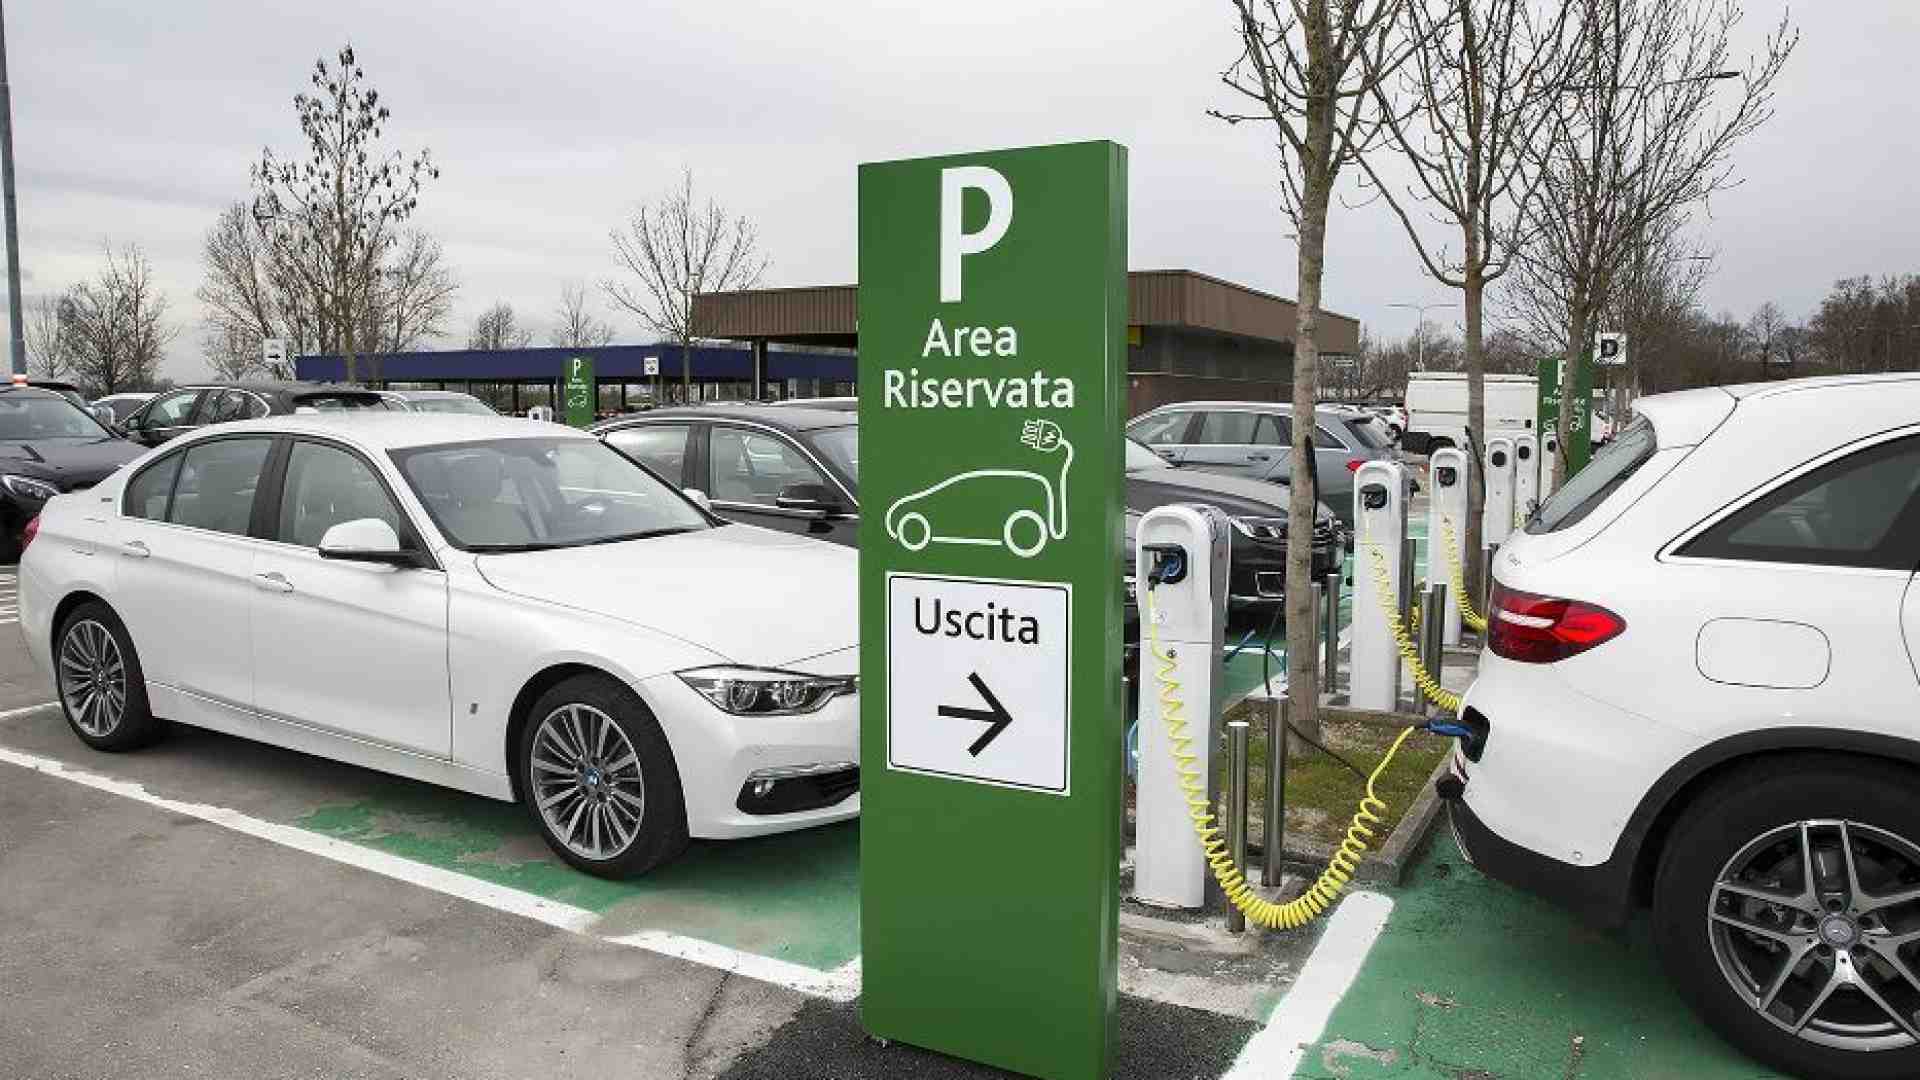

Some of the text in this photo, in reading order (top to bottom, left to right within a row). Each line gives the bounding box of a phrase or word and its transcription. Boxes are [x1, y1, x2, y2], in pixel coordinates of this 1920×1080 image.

[940, 165, 1014, 303] P
[921, 318, 1017, 357] Area
[1601, 339, 1618, 356] D
[573, 358, 581, 377] P
[884, 367, 1075, 409] Riservata
[914, 596, 1040, 645] Uscita
